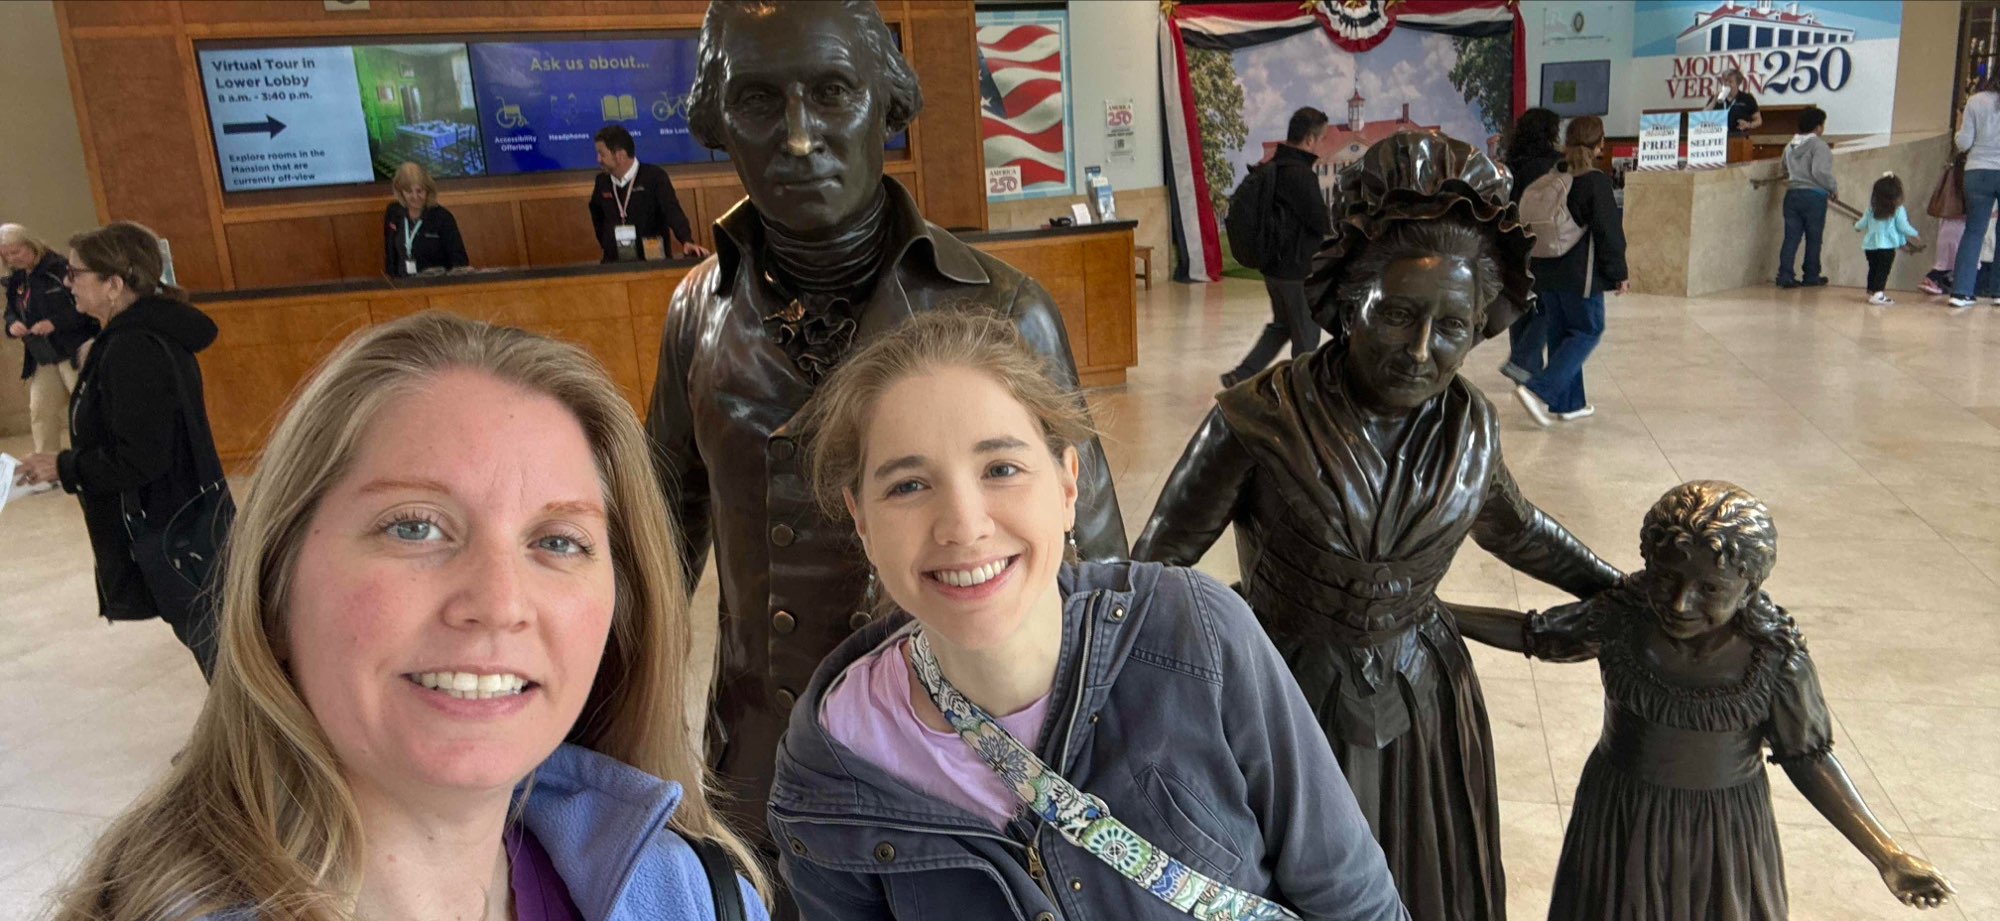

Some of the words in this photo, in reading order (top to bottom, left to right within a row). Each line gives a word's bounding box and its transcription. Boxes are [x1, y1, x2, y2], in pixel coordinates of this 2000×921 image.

[212, 59, 263, 72] Virtual
[266, 58, 299, 69] Tour
[302, 57, 316, 69] in
[530, 57, 561, 71] Ask
[565, 58, 584, 70] us
[588, 56, 650, 69] about...
[1673, 52, 1762, 78] MOUNT
[1764, 47, 1851, 94] 250
[215, 76, 260, 89] Lower
[264, 73, 310, 88] Lobby
[218, 94, 226, 103] 8
[228, 93, 252, 102] a.m.
[261, 91, 287, 101] 3:40
[289, 90, 313, 101] p.m.
[1108, 111, 1132, 126] 250
[660, 127, 673, 135] Bike
[494, 135, 538, 145] Accessibility
[549, 133, 590, 142] Headphones
[1690, 138, 1724, 148] SELFIE
[501, 143, 534, 152] Offerings
[1642, 140, 1676, 151] FREE
[229, 152, 265, 163] Explore
[268, 151, 297, 161] rooms
[299, 150, 309, 159] in
[311, 149, 326, 159] the
[1641, 153, 1676, 162] PHOTOS
[1690, 149, 1724, 158] STATION
[231, 164, 270, 174] Mansion
[273, 163, 291, 172] that
[295, 162, 309, 171] are
[989, 168, 1017, 177] AMERICA
[233, 174, 276, 186] currently
[278, 172, 316, 183] off-view
[989, 176, 1018, 193] 250
